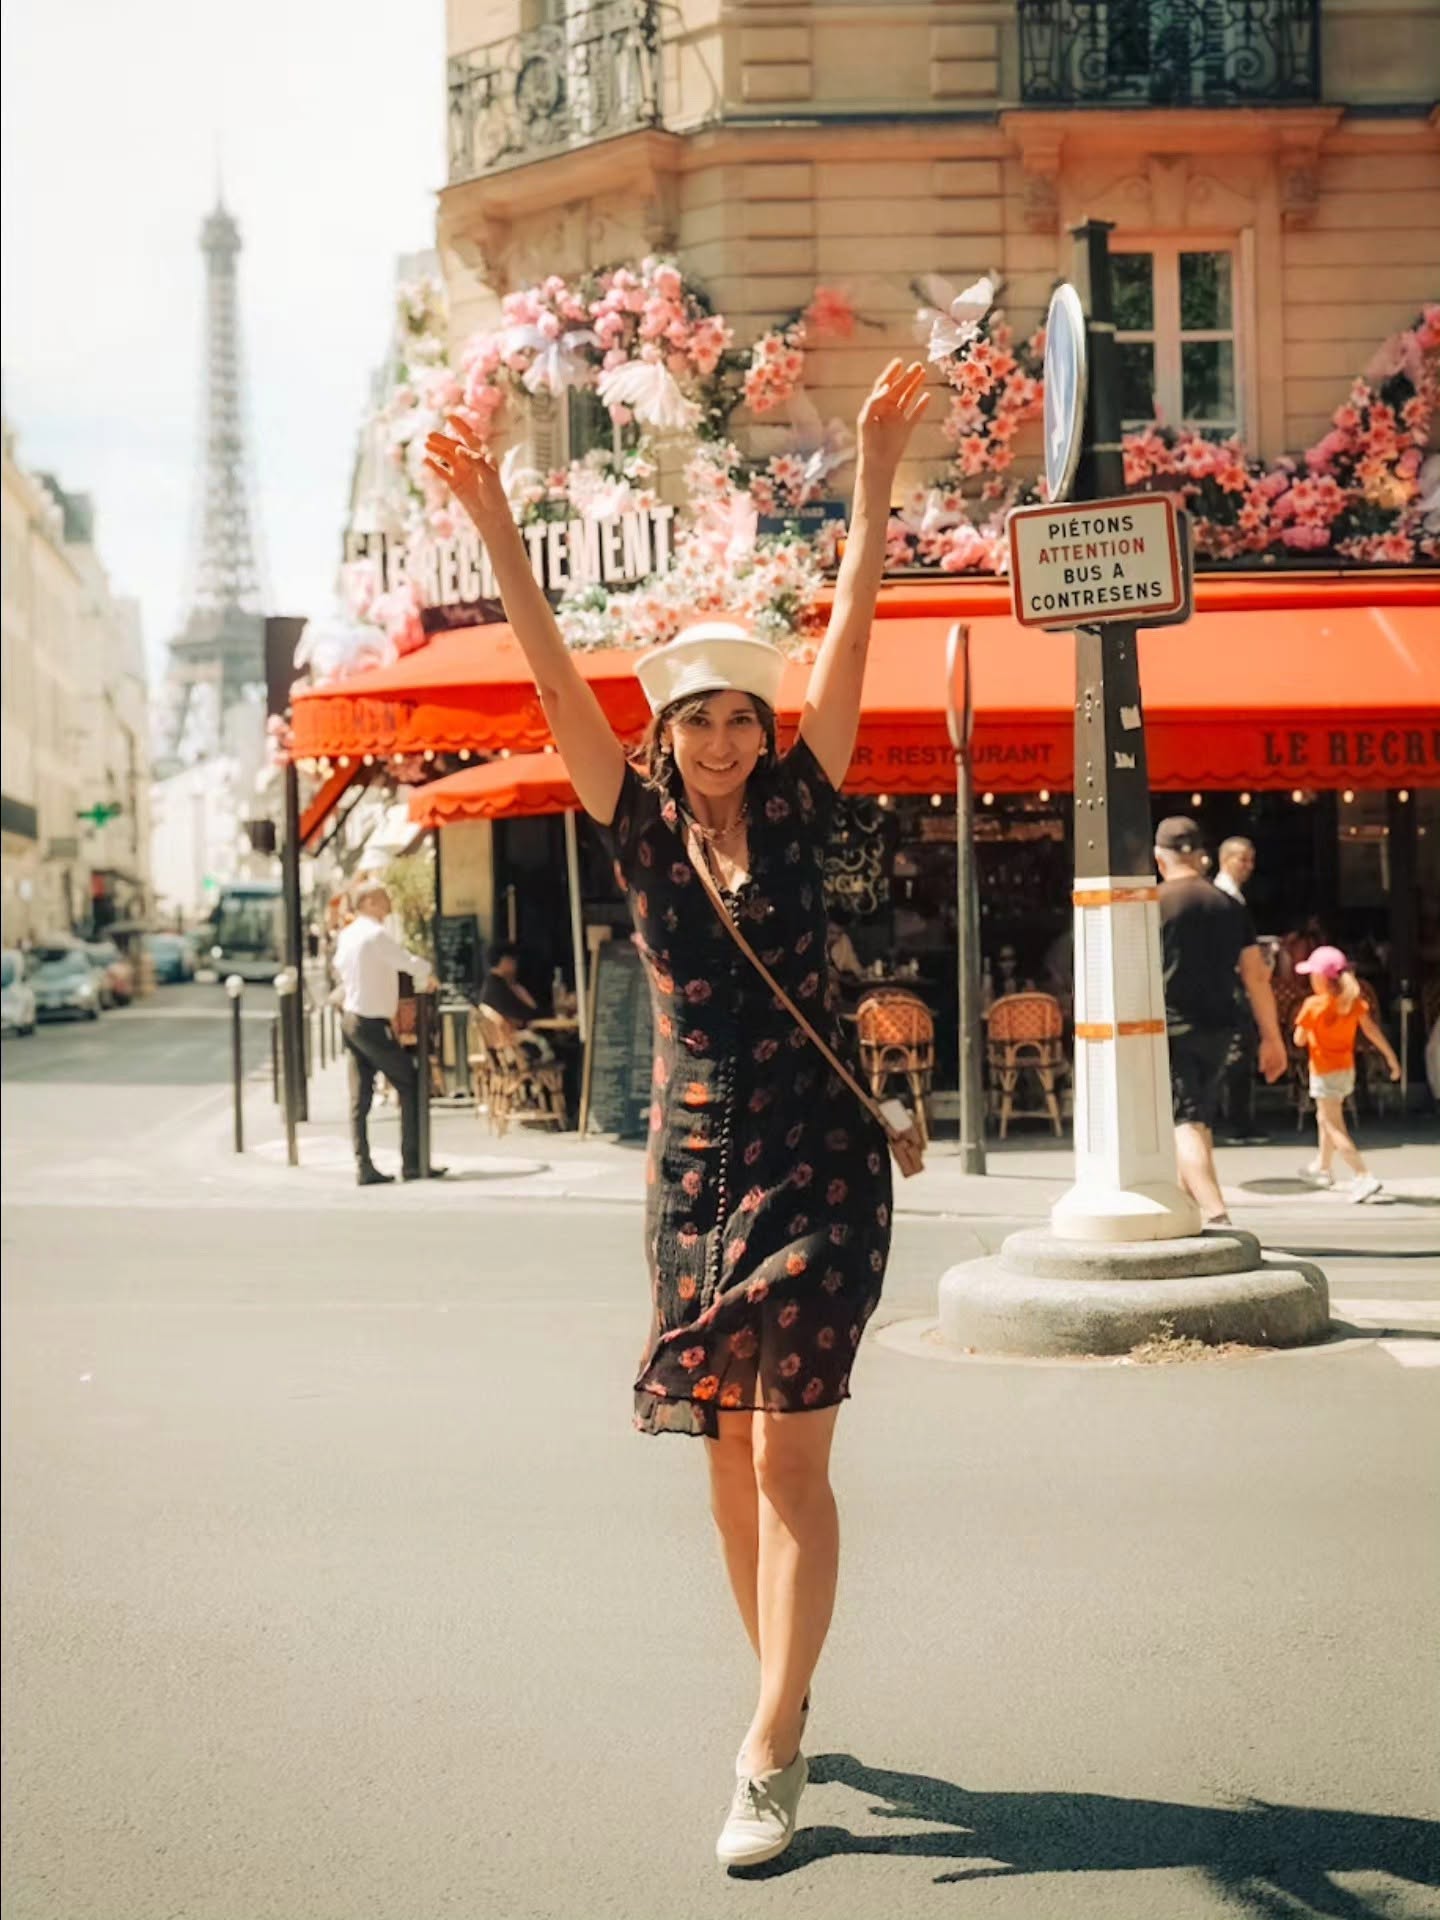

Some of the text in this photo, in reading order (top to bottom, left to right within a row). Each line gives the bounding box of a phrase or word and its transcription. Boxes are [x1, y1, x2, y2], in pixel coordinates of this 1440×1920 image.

[1049, 516, 1134, 539] PIÉTONS
[1039, 537, 1145, 564] ATTENTION
[1064, 563, 1124, 584] BUS A
[1031, 581, 1163, 611] CONTRESENS
[887, 744, 1055, 766] RESTURANT
[1262, 730, 1309, 767] LE
